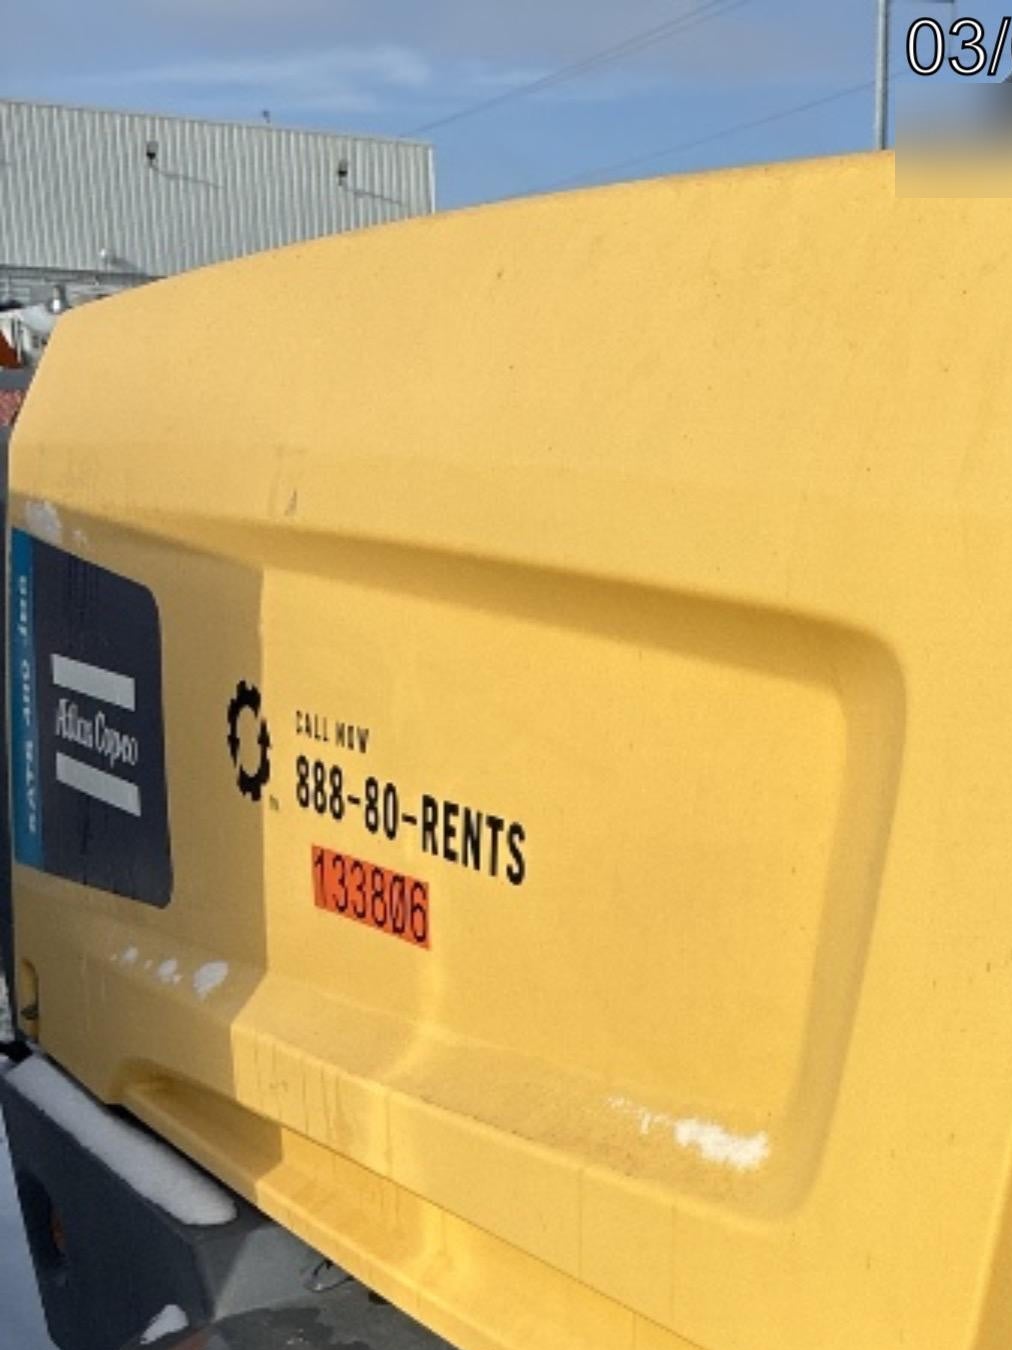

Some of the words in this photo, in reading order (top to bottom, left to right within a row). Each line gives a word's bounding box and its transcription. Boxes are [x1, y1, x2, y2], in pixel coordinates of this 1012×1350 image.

[56, 698, 93, 749] Atlas
[296, 710, 330, 742] CALL
[335, 721, 370, 754] NOW
[296, 755, 526, 885] 888-80-RENTS
[315, 848, 426, 943] 133806
